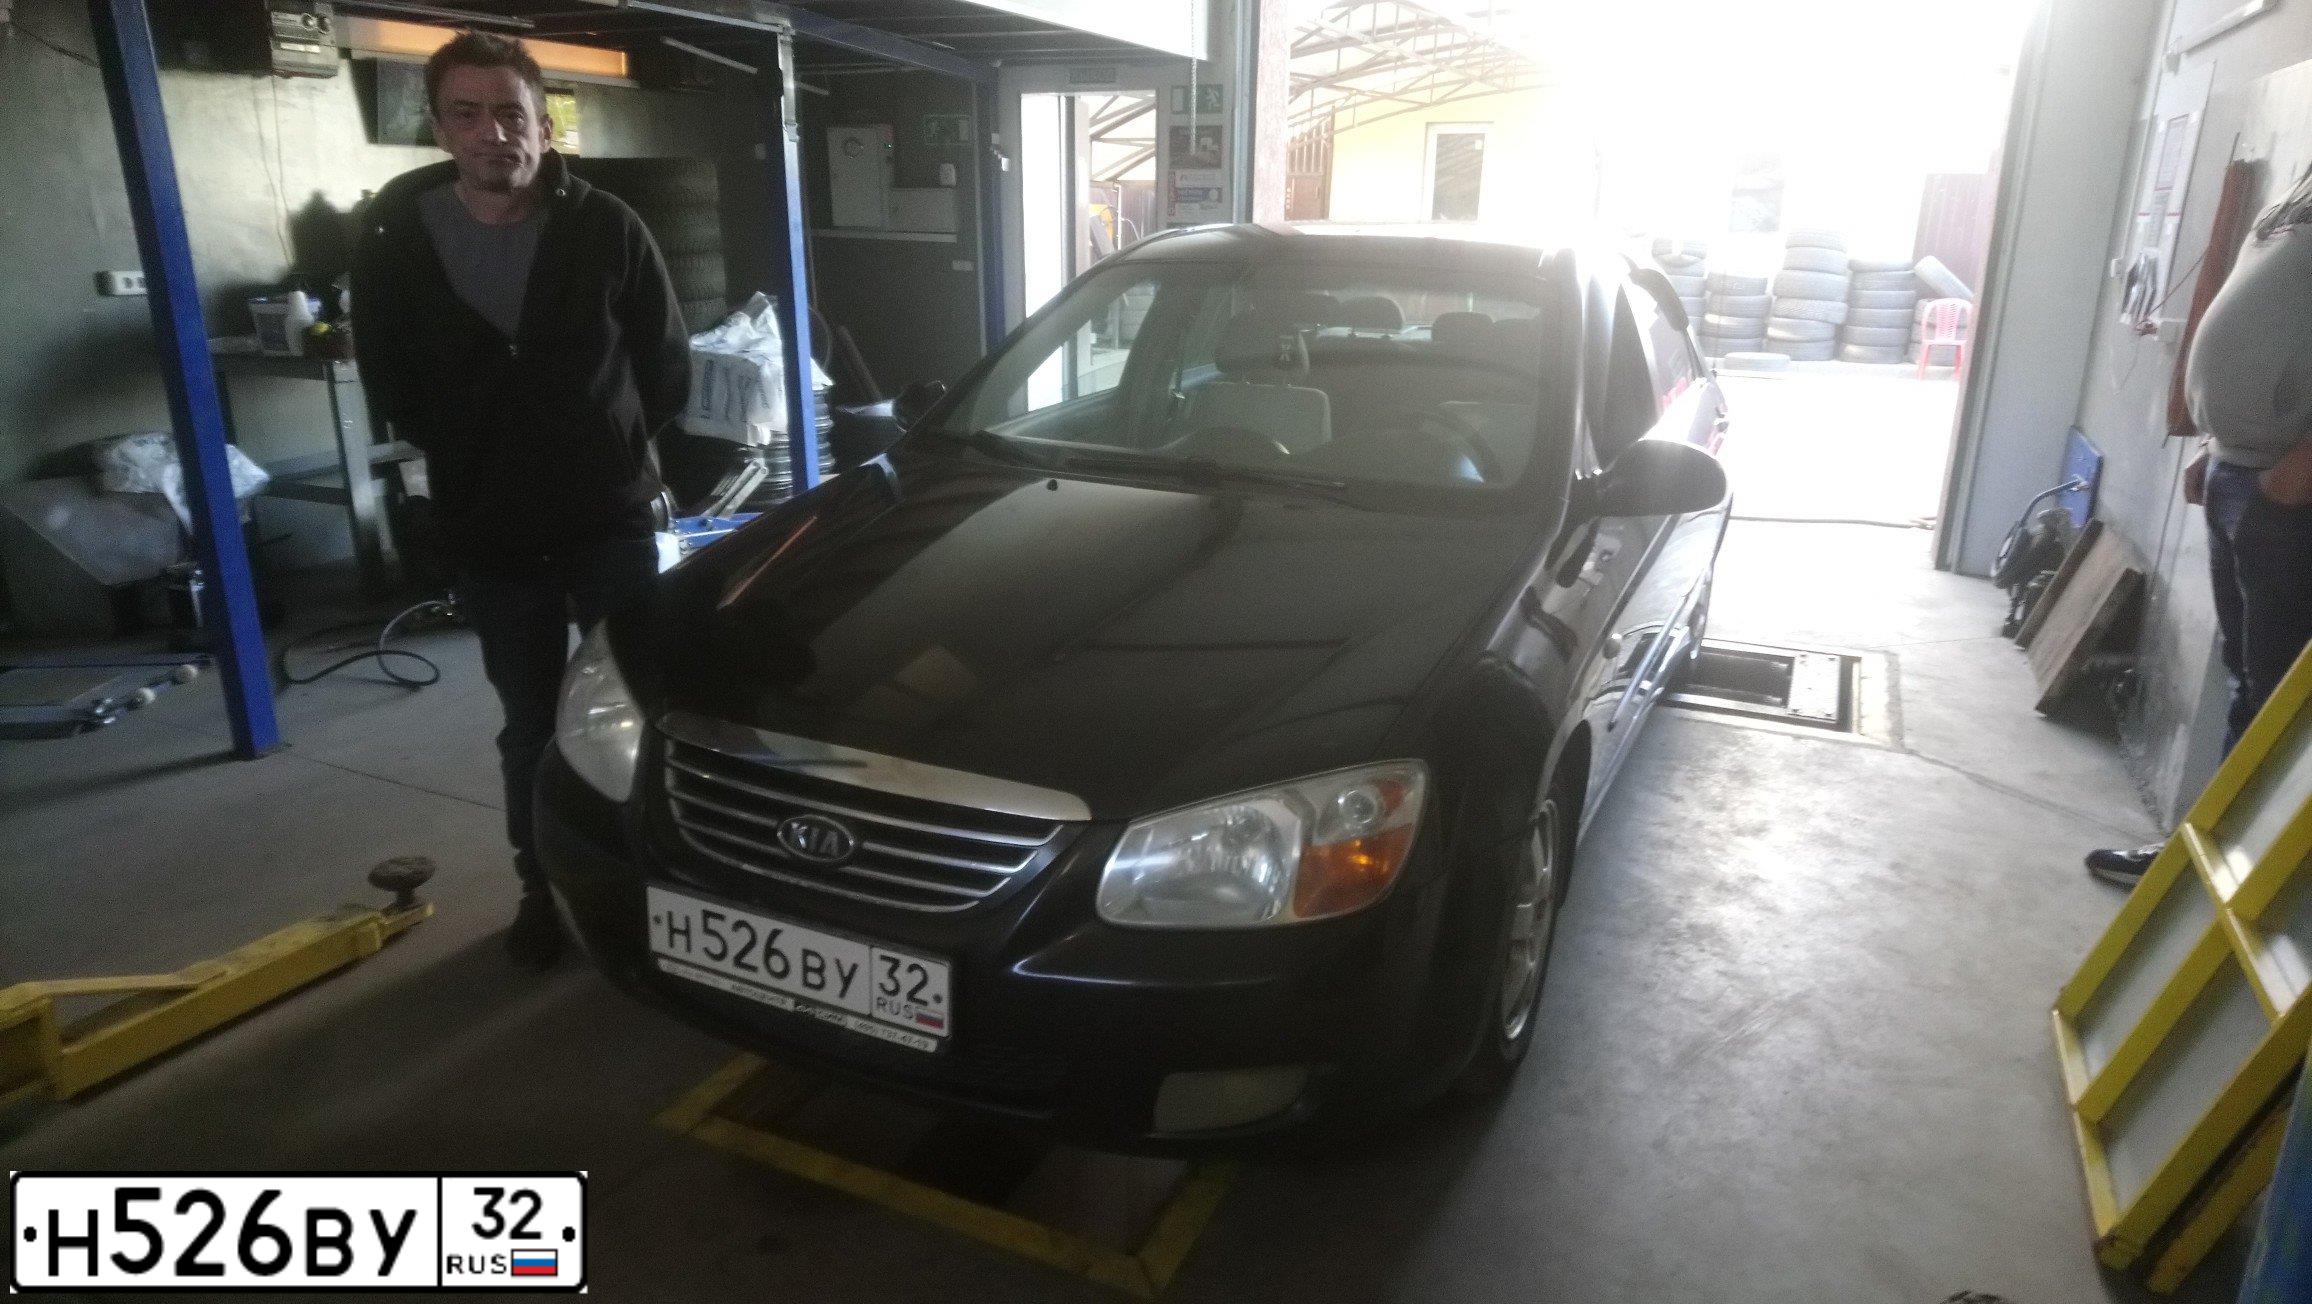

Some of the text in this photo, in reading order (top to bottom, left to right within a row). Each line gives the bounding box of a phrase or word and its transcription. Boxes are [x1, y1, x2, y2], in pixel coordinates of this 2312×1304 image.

[791, 821, 839, 858] KIA
[877, 955, 929, 1007] 32
[876, 996, 915, 1020] RUS
